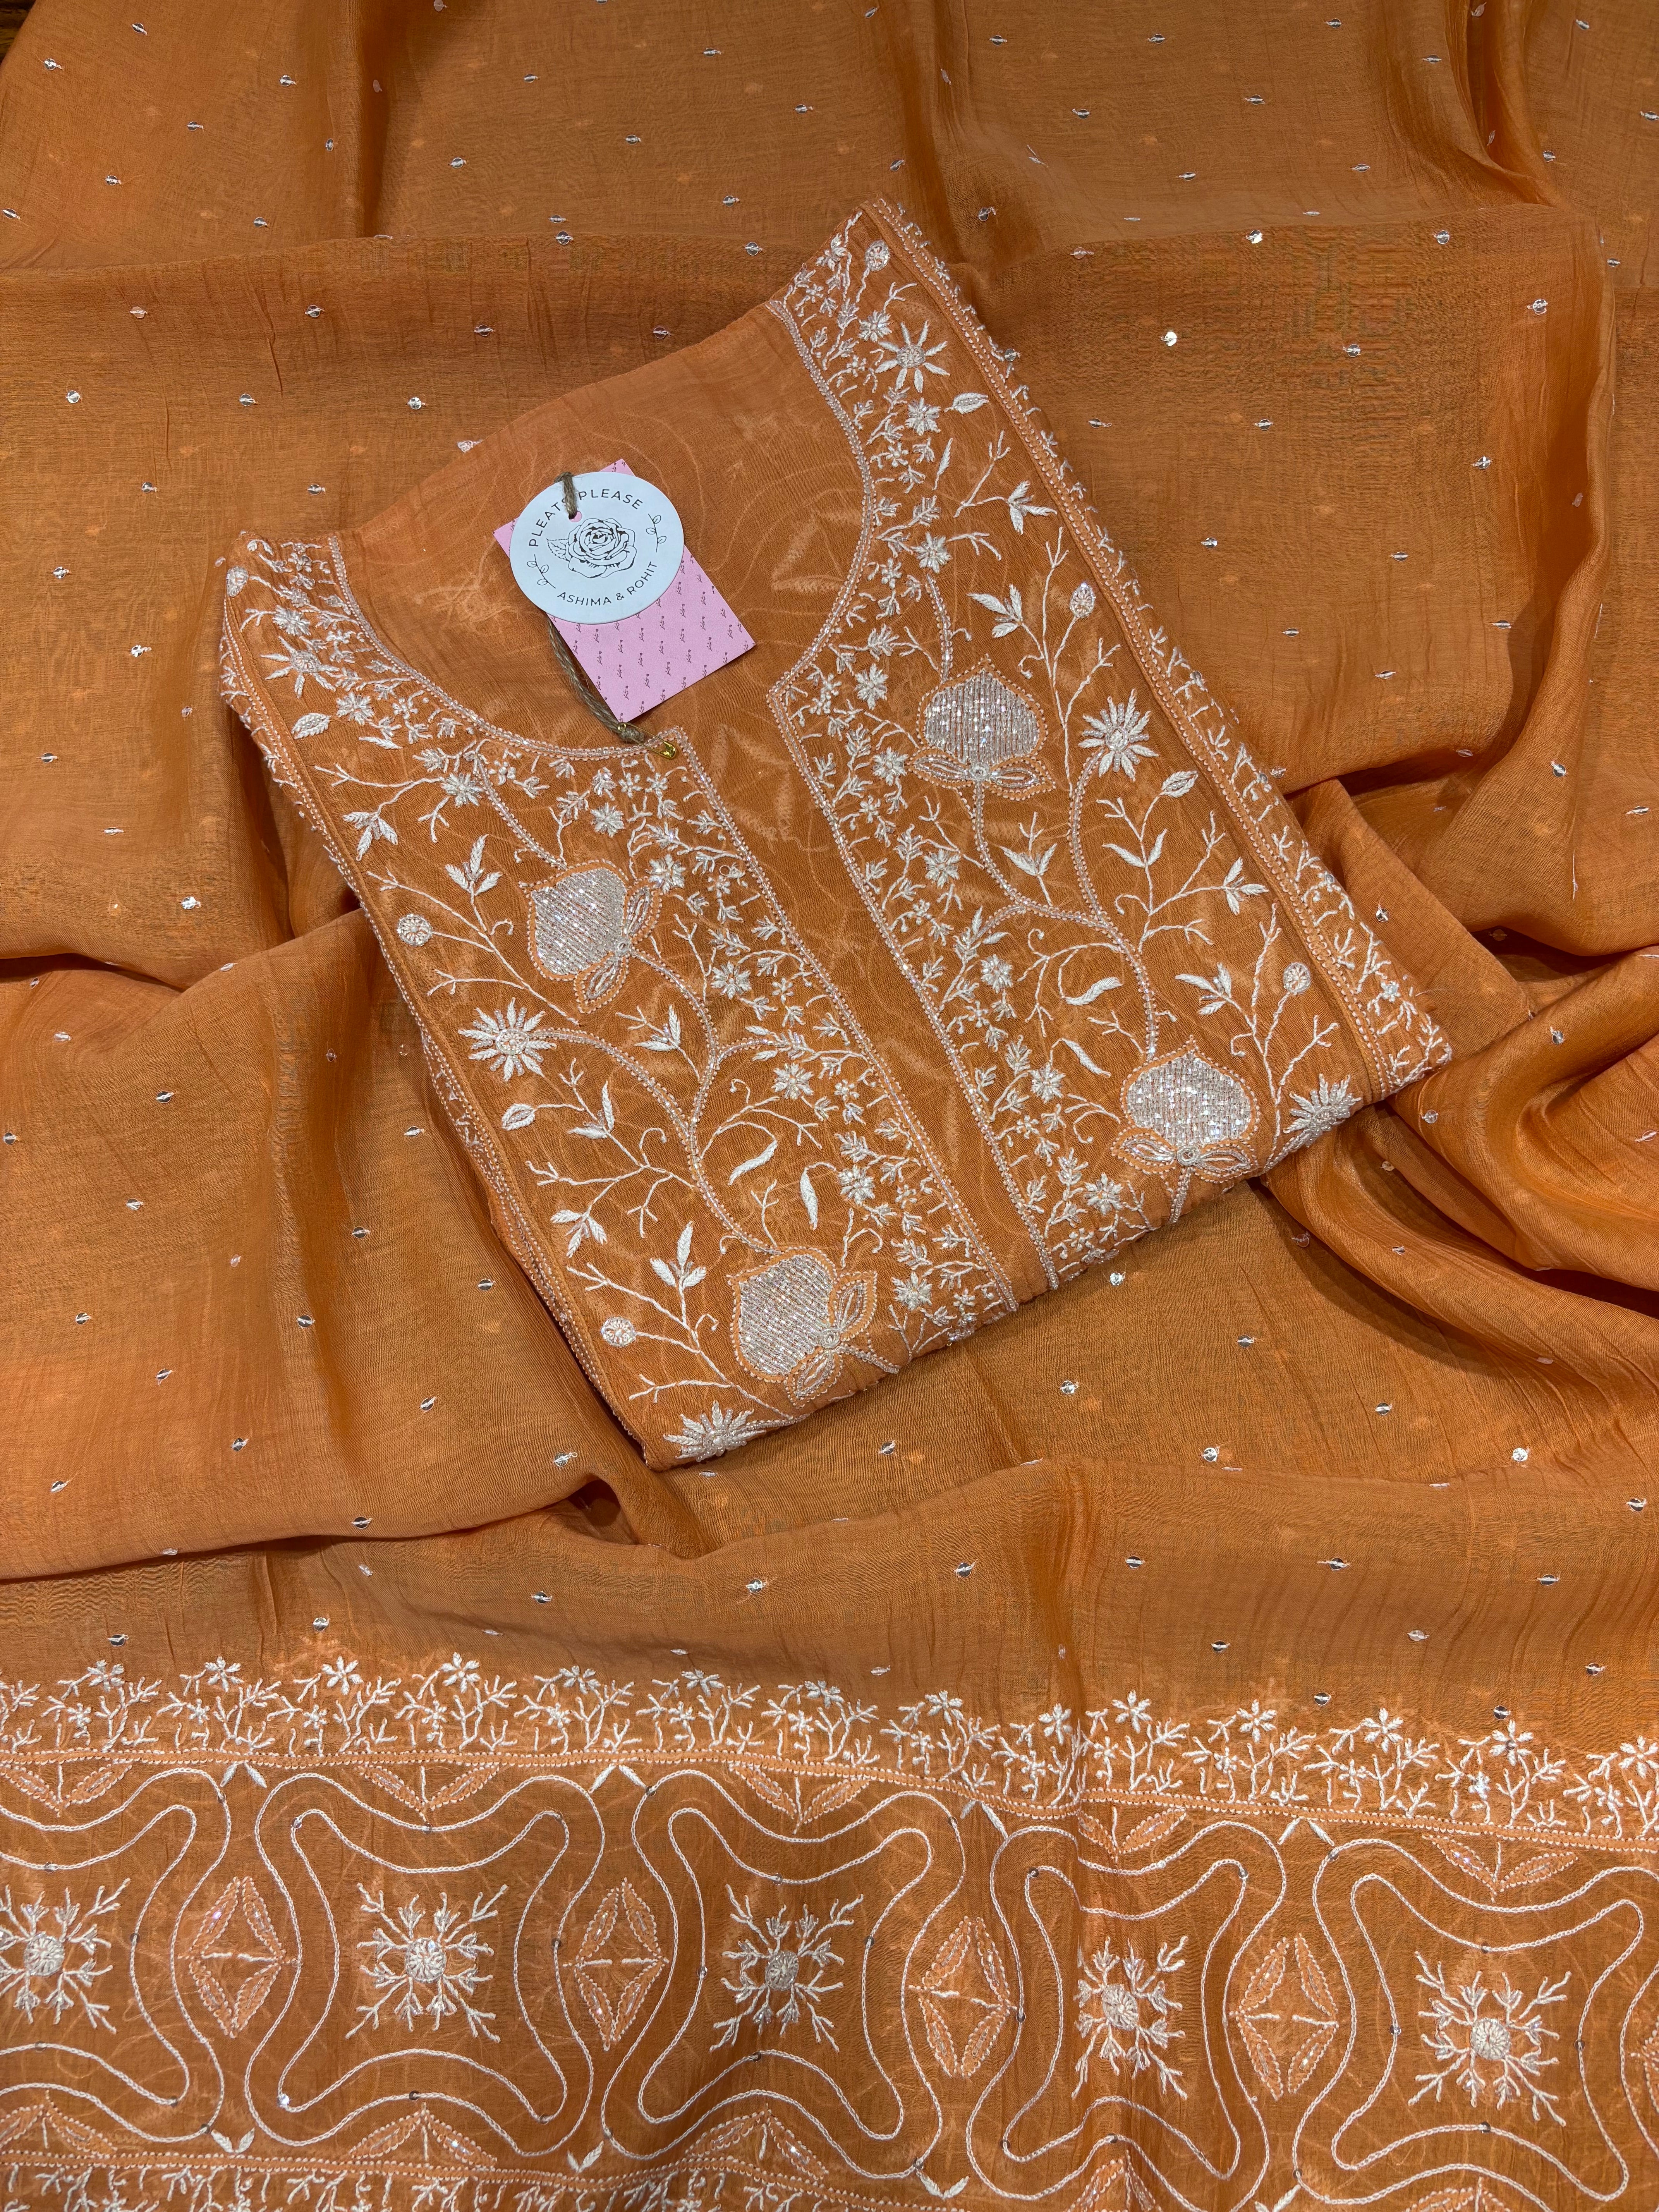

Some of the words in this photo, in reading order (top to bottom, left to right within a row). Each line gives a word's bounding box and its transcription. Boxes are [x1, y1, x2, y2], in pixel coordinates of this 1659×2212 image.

[578, 489, 643, 510] PLEASE
[557, 592, 612, 606] ASHIMA
[616, 592, 625, 601] &
[627, 561, 657, 595] ROHIT
